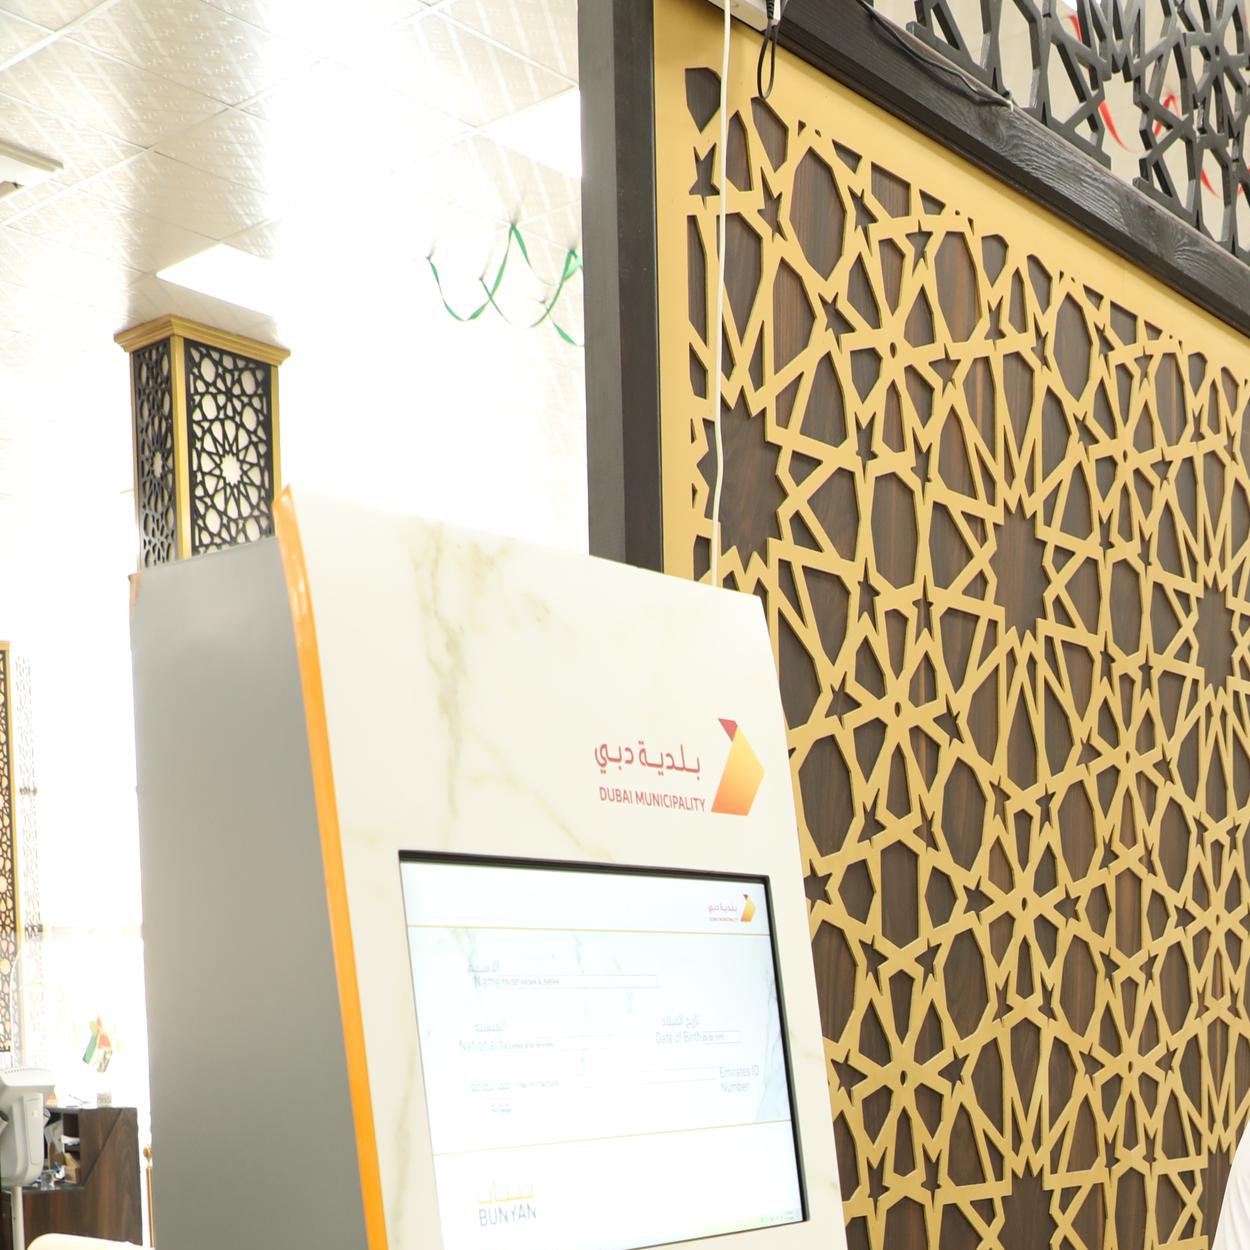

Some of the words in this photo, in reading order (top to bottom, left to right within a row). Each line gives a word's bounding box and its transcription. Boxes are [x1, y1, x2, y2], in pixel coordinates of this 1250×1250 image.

[594, 743, 634, 774] دبي
[638, 740, 701, 780] بلدية
[599, 786, 633, 805] DUBAI
[635, 790, 706, 812] MUNICIPALITY
[478, 1202, 537, 1227] BUNYAN
